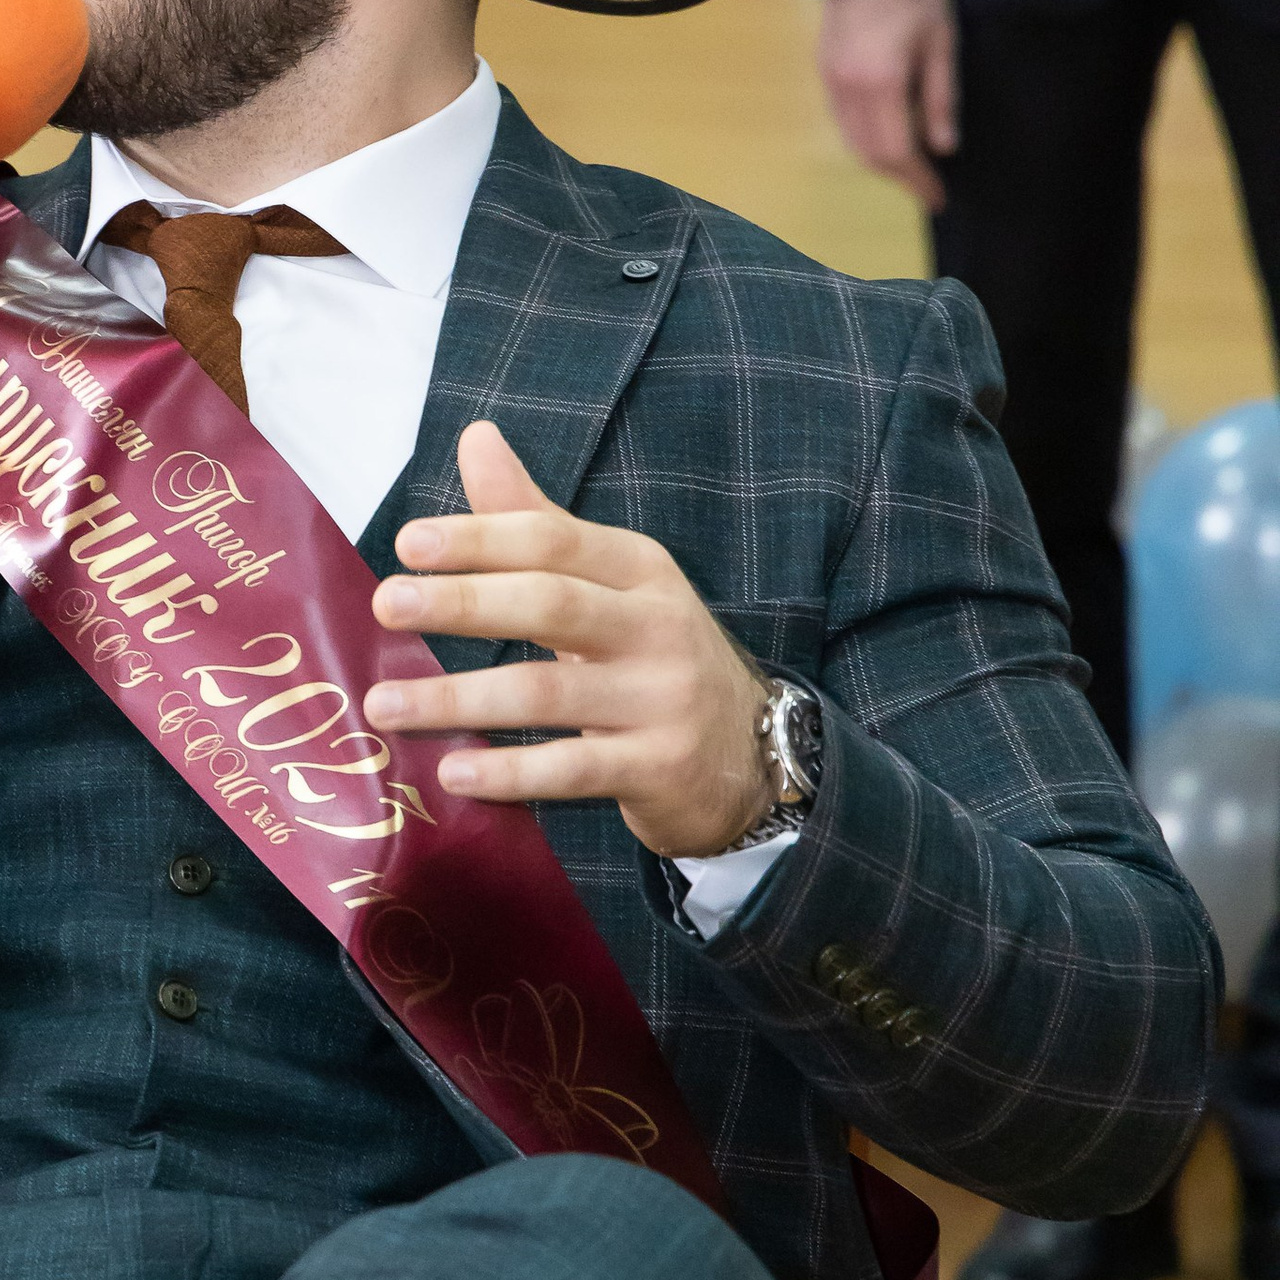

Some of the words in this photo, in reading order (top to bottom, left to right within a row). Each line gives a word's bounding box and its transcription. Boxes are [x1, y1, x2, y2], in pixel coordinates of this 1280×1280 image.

[27, 314, 155, 462] Даниелян
[152, 450, 288, 590] Григор
[157, 690, 270, 810] СОШ
[245, 800, 300, 846] №16
[182, 632, 438, 840] 2023
